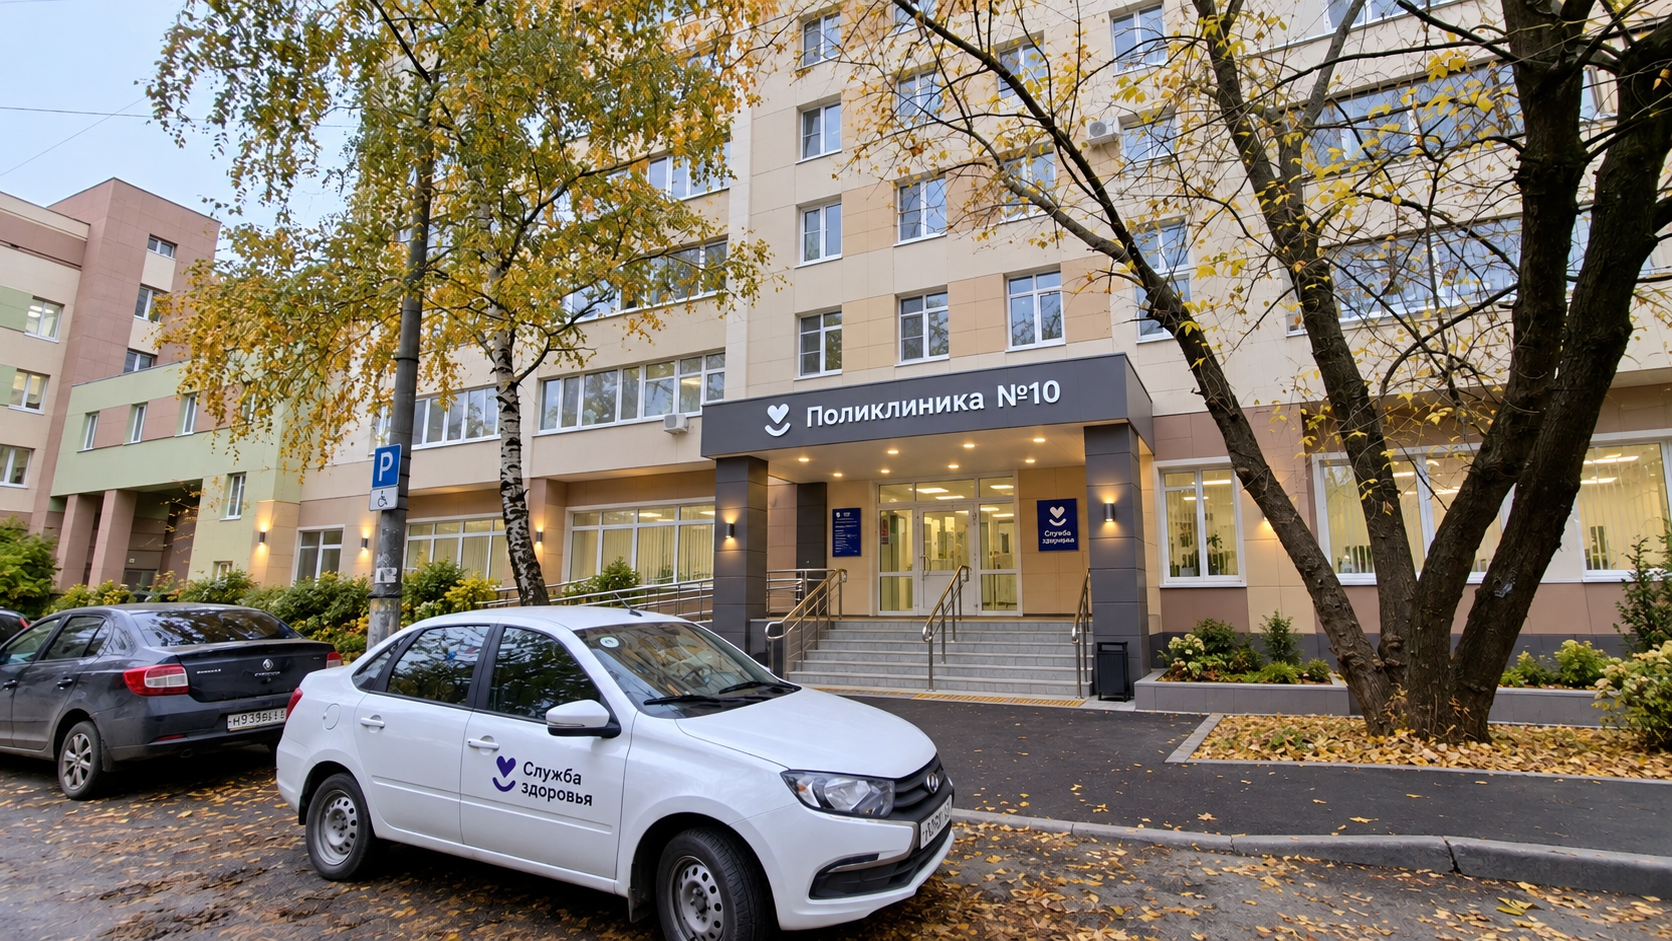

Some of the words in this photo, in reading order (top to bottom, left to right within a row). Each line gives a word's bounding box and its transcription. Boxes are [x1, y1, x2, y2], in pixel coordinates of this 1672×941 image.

[807, 392, 985, 428] Поликлиника
[997, 380, 1061, 408] №10
[378, 451, 394, 482] P
[523, 761, 582, 786] Служба
[521, 782, 593, 806] здоровья
